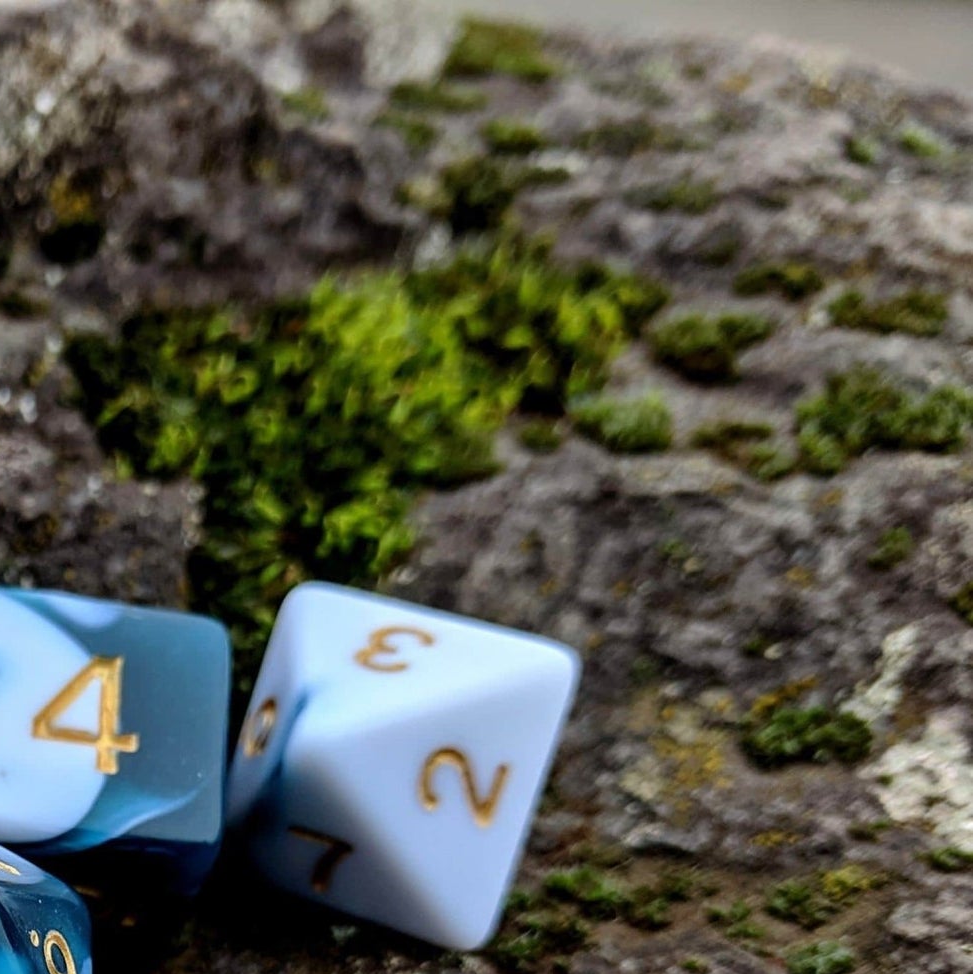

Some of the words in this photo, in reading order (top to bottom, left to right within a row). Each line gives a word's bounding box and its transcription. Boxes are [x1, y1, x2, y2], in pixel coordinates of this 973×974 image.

[354, 625, 434, 672] 3
[32, 654, 140, 775] 4
[418, 745, 510, 828] 2
